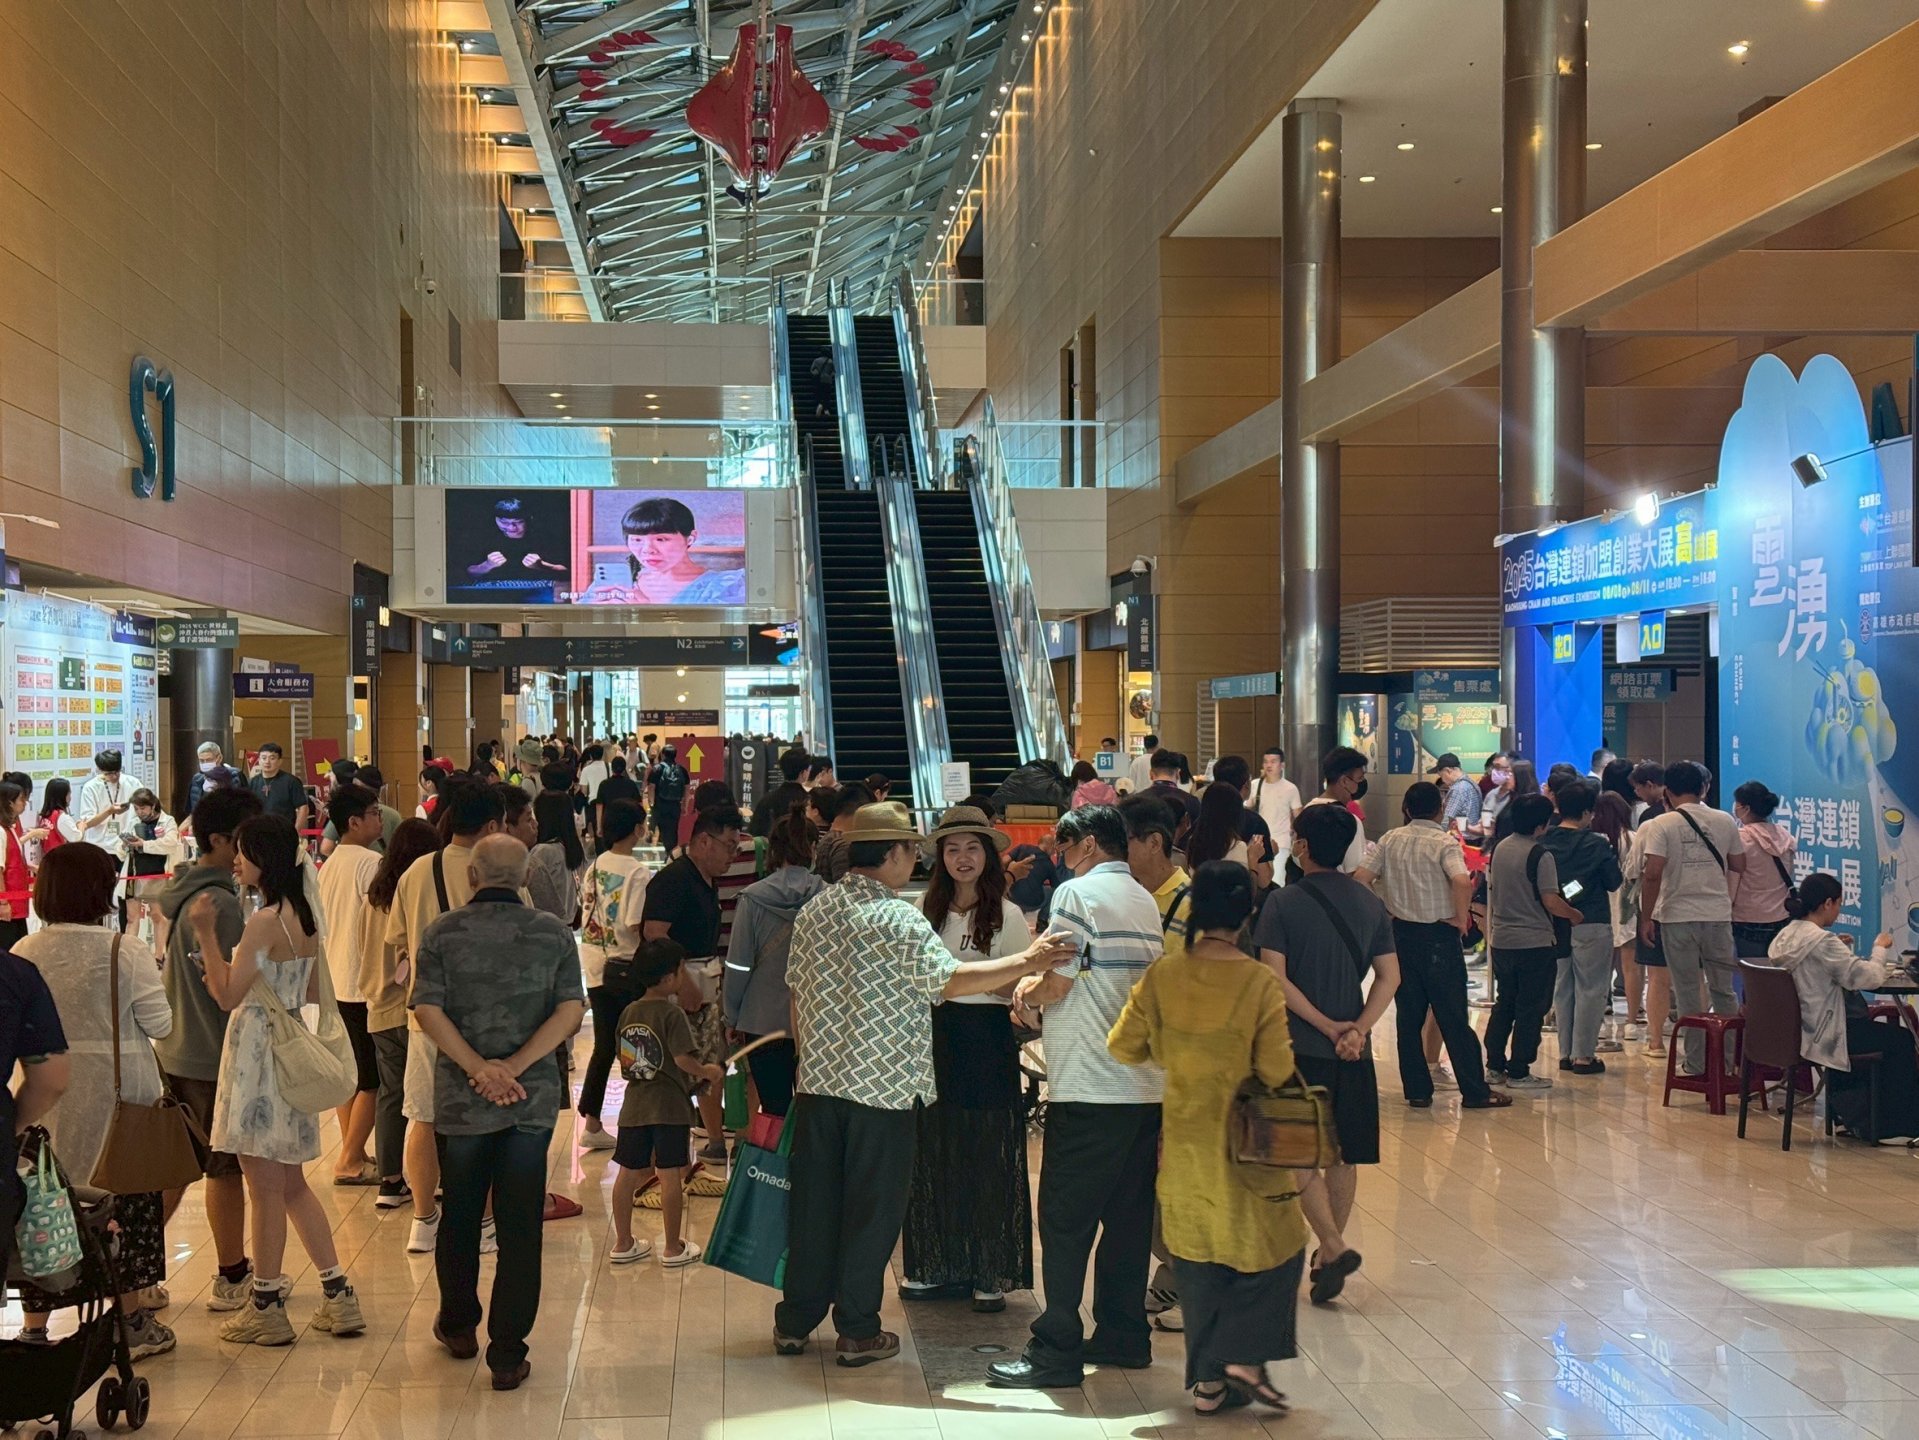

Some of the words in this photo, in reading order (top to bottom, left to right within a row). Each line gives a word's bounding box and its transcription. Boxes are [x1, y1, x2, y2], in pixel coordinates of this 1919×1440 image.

[130, 355, 175, 503] S1
[353, 598, 364, 607] S1
[1128, 596, 1139, 605] N1
[676, 638, 693, 649] N2
[1641, 623, 1662, 652] 入口
[1555, 634, 1572, 659] 出口
[267, 678, 310, 687] 大會服務台
[1610, 672, 1663, 686] 網路訂票
[1453, 680, 1492, 693] 售票處
[1617, 686, 1656, 699] 領取處
[1100, 756, 1113, 767] B1
[1773, 795, 1861, 850] 台灣連鎖
[626, 1027, 650, 1038] NASA
[747, 1166, 791, 1191] Omada
